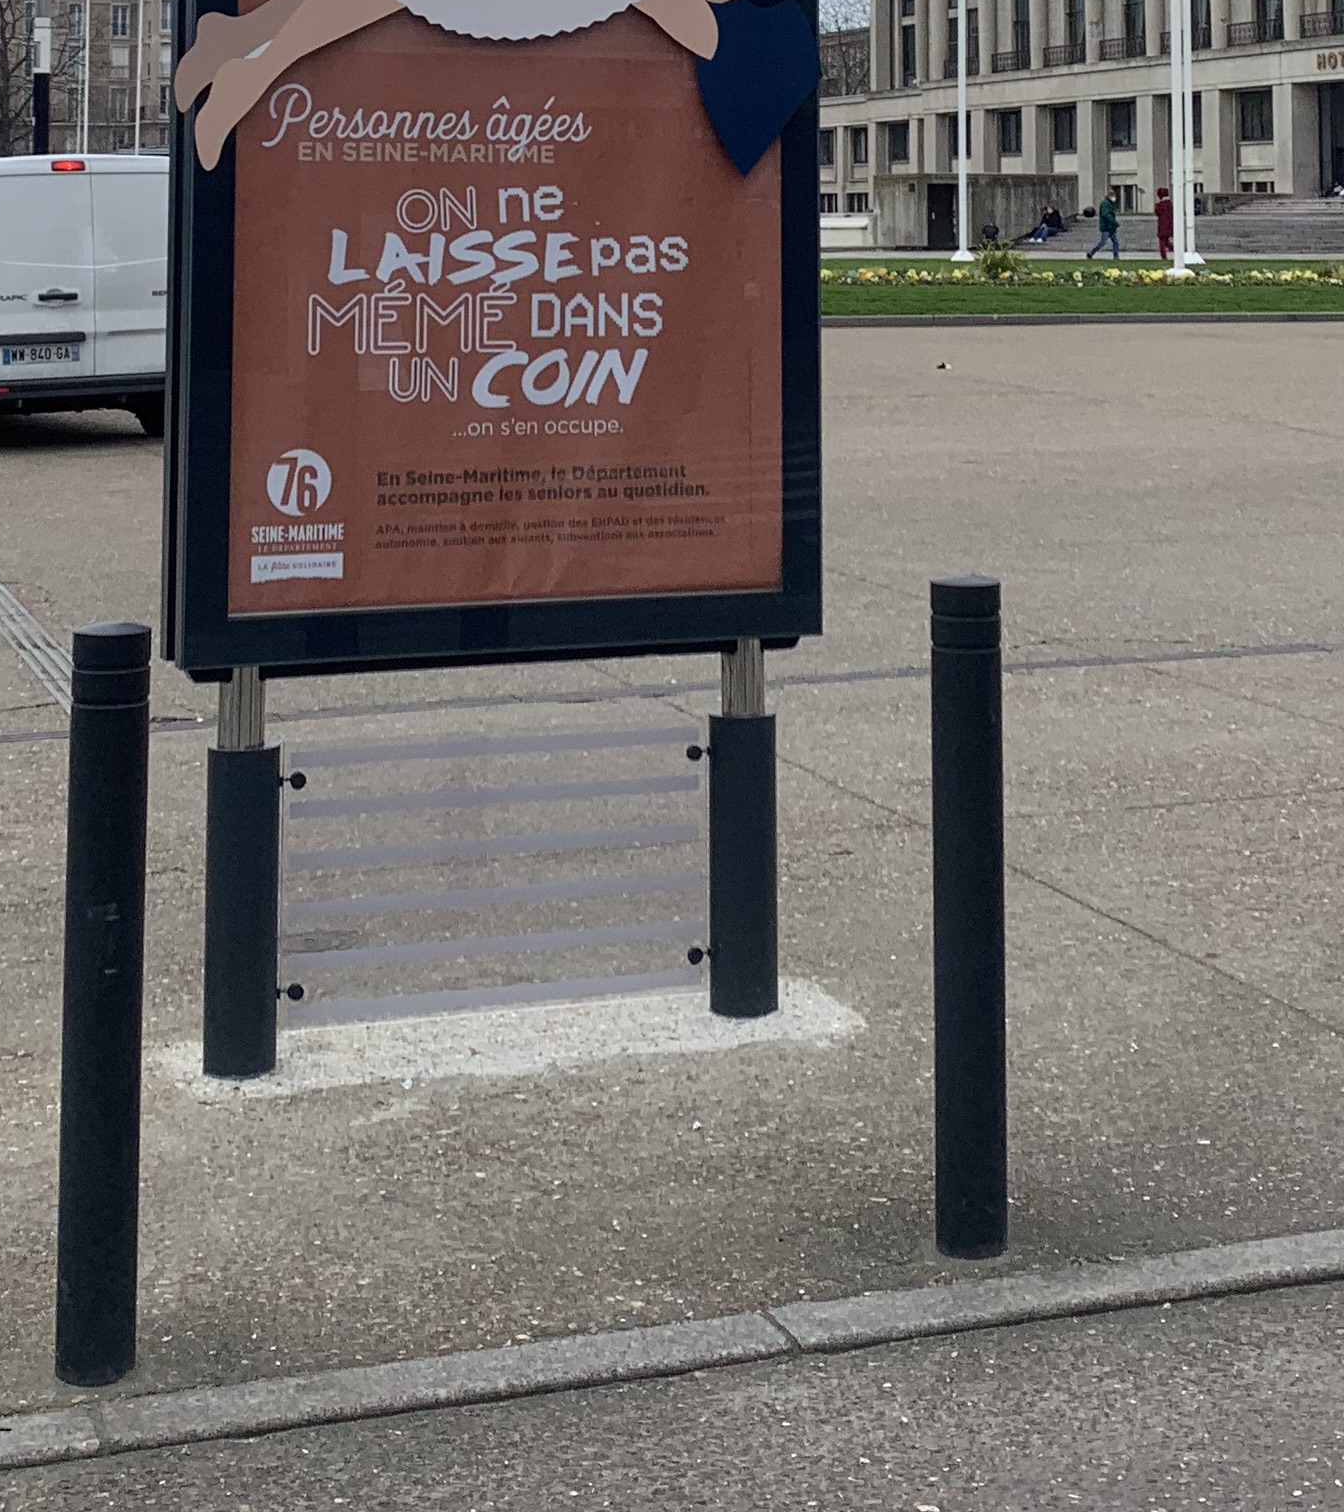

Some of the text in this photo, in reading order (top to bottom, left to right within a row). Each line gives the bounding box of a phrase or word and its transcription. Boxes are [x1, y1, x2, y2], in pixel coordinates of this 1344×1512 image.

[262, 83, 592, 162] Personnes âgées
[298, 141, 333, 162] EN
[396, 185, 564, 233] ON ne
[327, 227, 689, 286] LAISSE pas
[307, 278, 664, 355] MÉMÉ DANS
[388, 348, 649, 409] UN COIN
[500, 417, 539, 436] s'en
[544, 420, 624, 438] occupe.
[271, 455, 320, 516] 76
[376, 490, 494, 508] accompagne
[499, 485, 523, 503] les
[597, 486, 618, 499] au
[623, 480, 711, 501] quotidien.
[377, 464, 687, 487] En Seine-Maritime, le Département
[250, 522, 345, 544] SEINE-MARITIME
